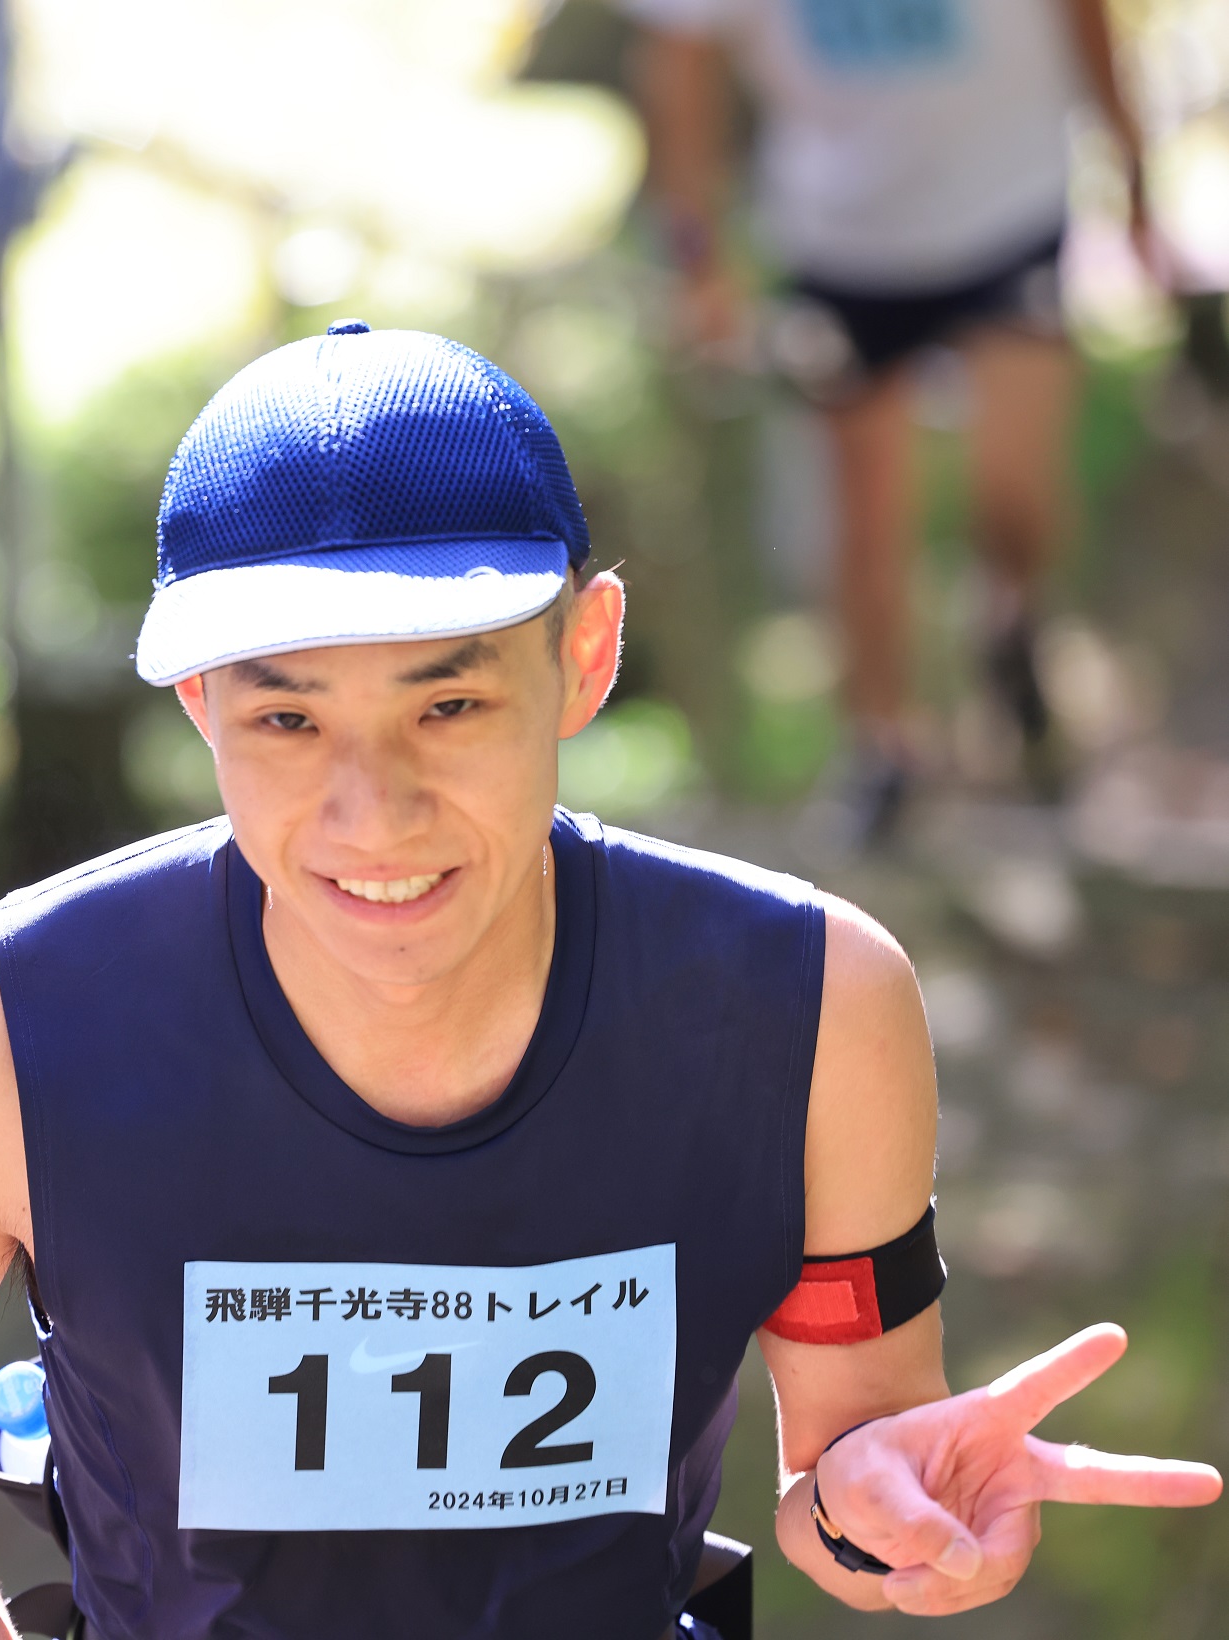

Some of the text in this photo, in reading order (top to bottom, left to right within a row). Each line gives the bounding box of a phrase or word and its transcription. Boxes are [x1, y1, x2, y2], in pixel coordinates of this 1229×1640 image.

[205, 1277, 650, 1323] 飛騨千光寺88トレイル
[268, 1350, 597, 1471] 112
[428, 1477, 628, 1510] 2024年10月27日
